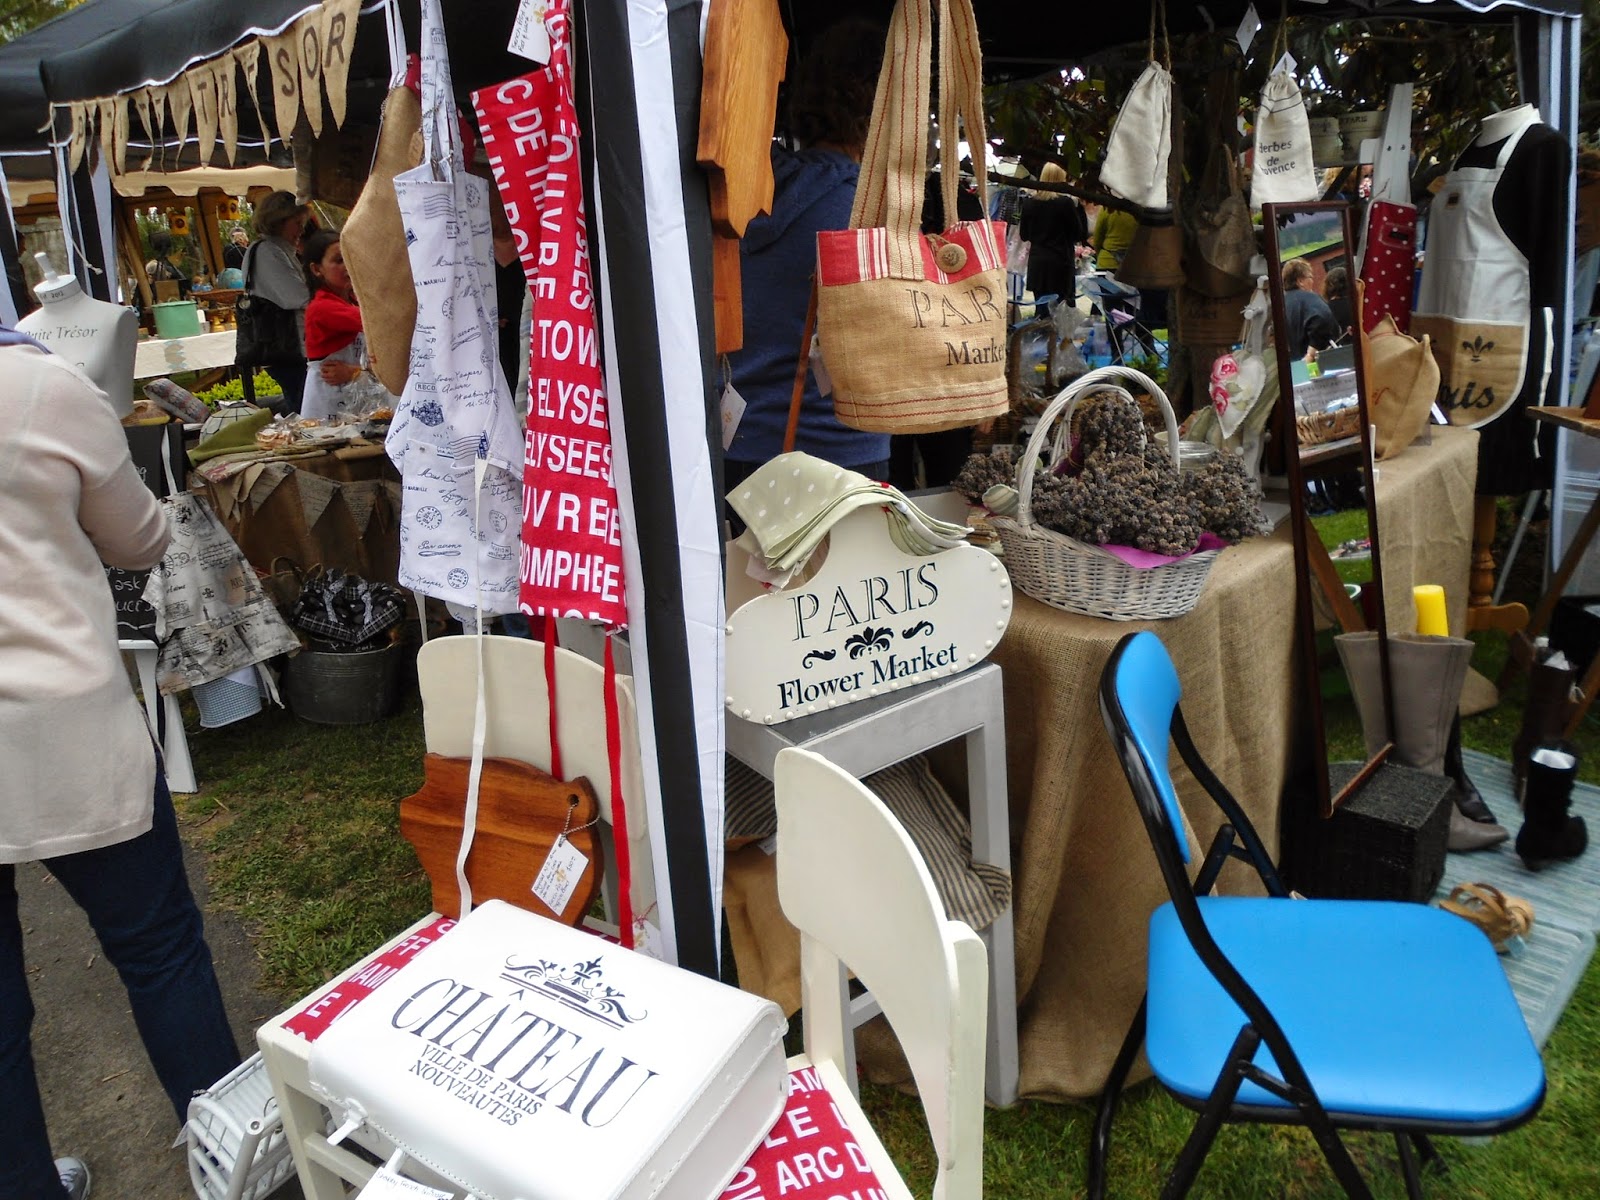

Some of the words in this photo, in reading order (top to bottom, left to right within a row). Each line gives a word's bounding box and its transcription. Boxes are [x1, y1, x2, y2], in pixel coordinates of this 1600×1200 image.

[1259, 161, 1295, 175] ovence
[1266, 156, 1279, 167] de
[57, 325, 98, 339] Trésor
[115, 576, 141, 591] ask
[787, 562, 939, 641] PARIS
[777, 670, 864, 710] Flower
[871, 643, 959, 686] Market
[391, 978, 660, 1128] CHÂTEAU
[420, 1044, 467, 1075] VILLE
[463, 1066, 493, 1089] DE
[490, 1081, 543, 1116] PARIS
[408, 1059, 523, 1127] NOUVEAUTES
[776, 1145, 844, 1197] ARC
